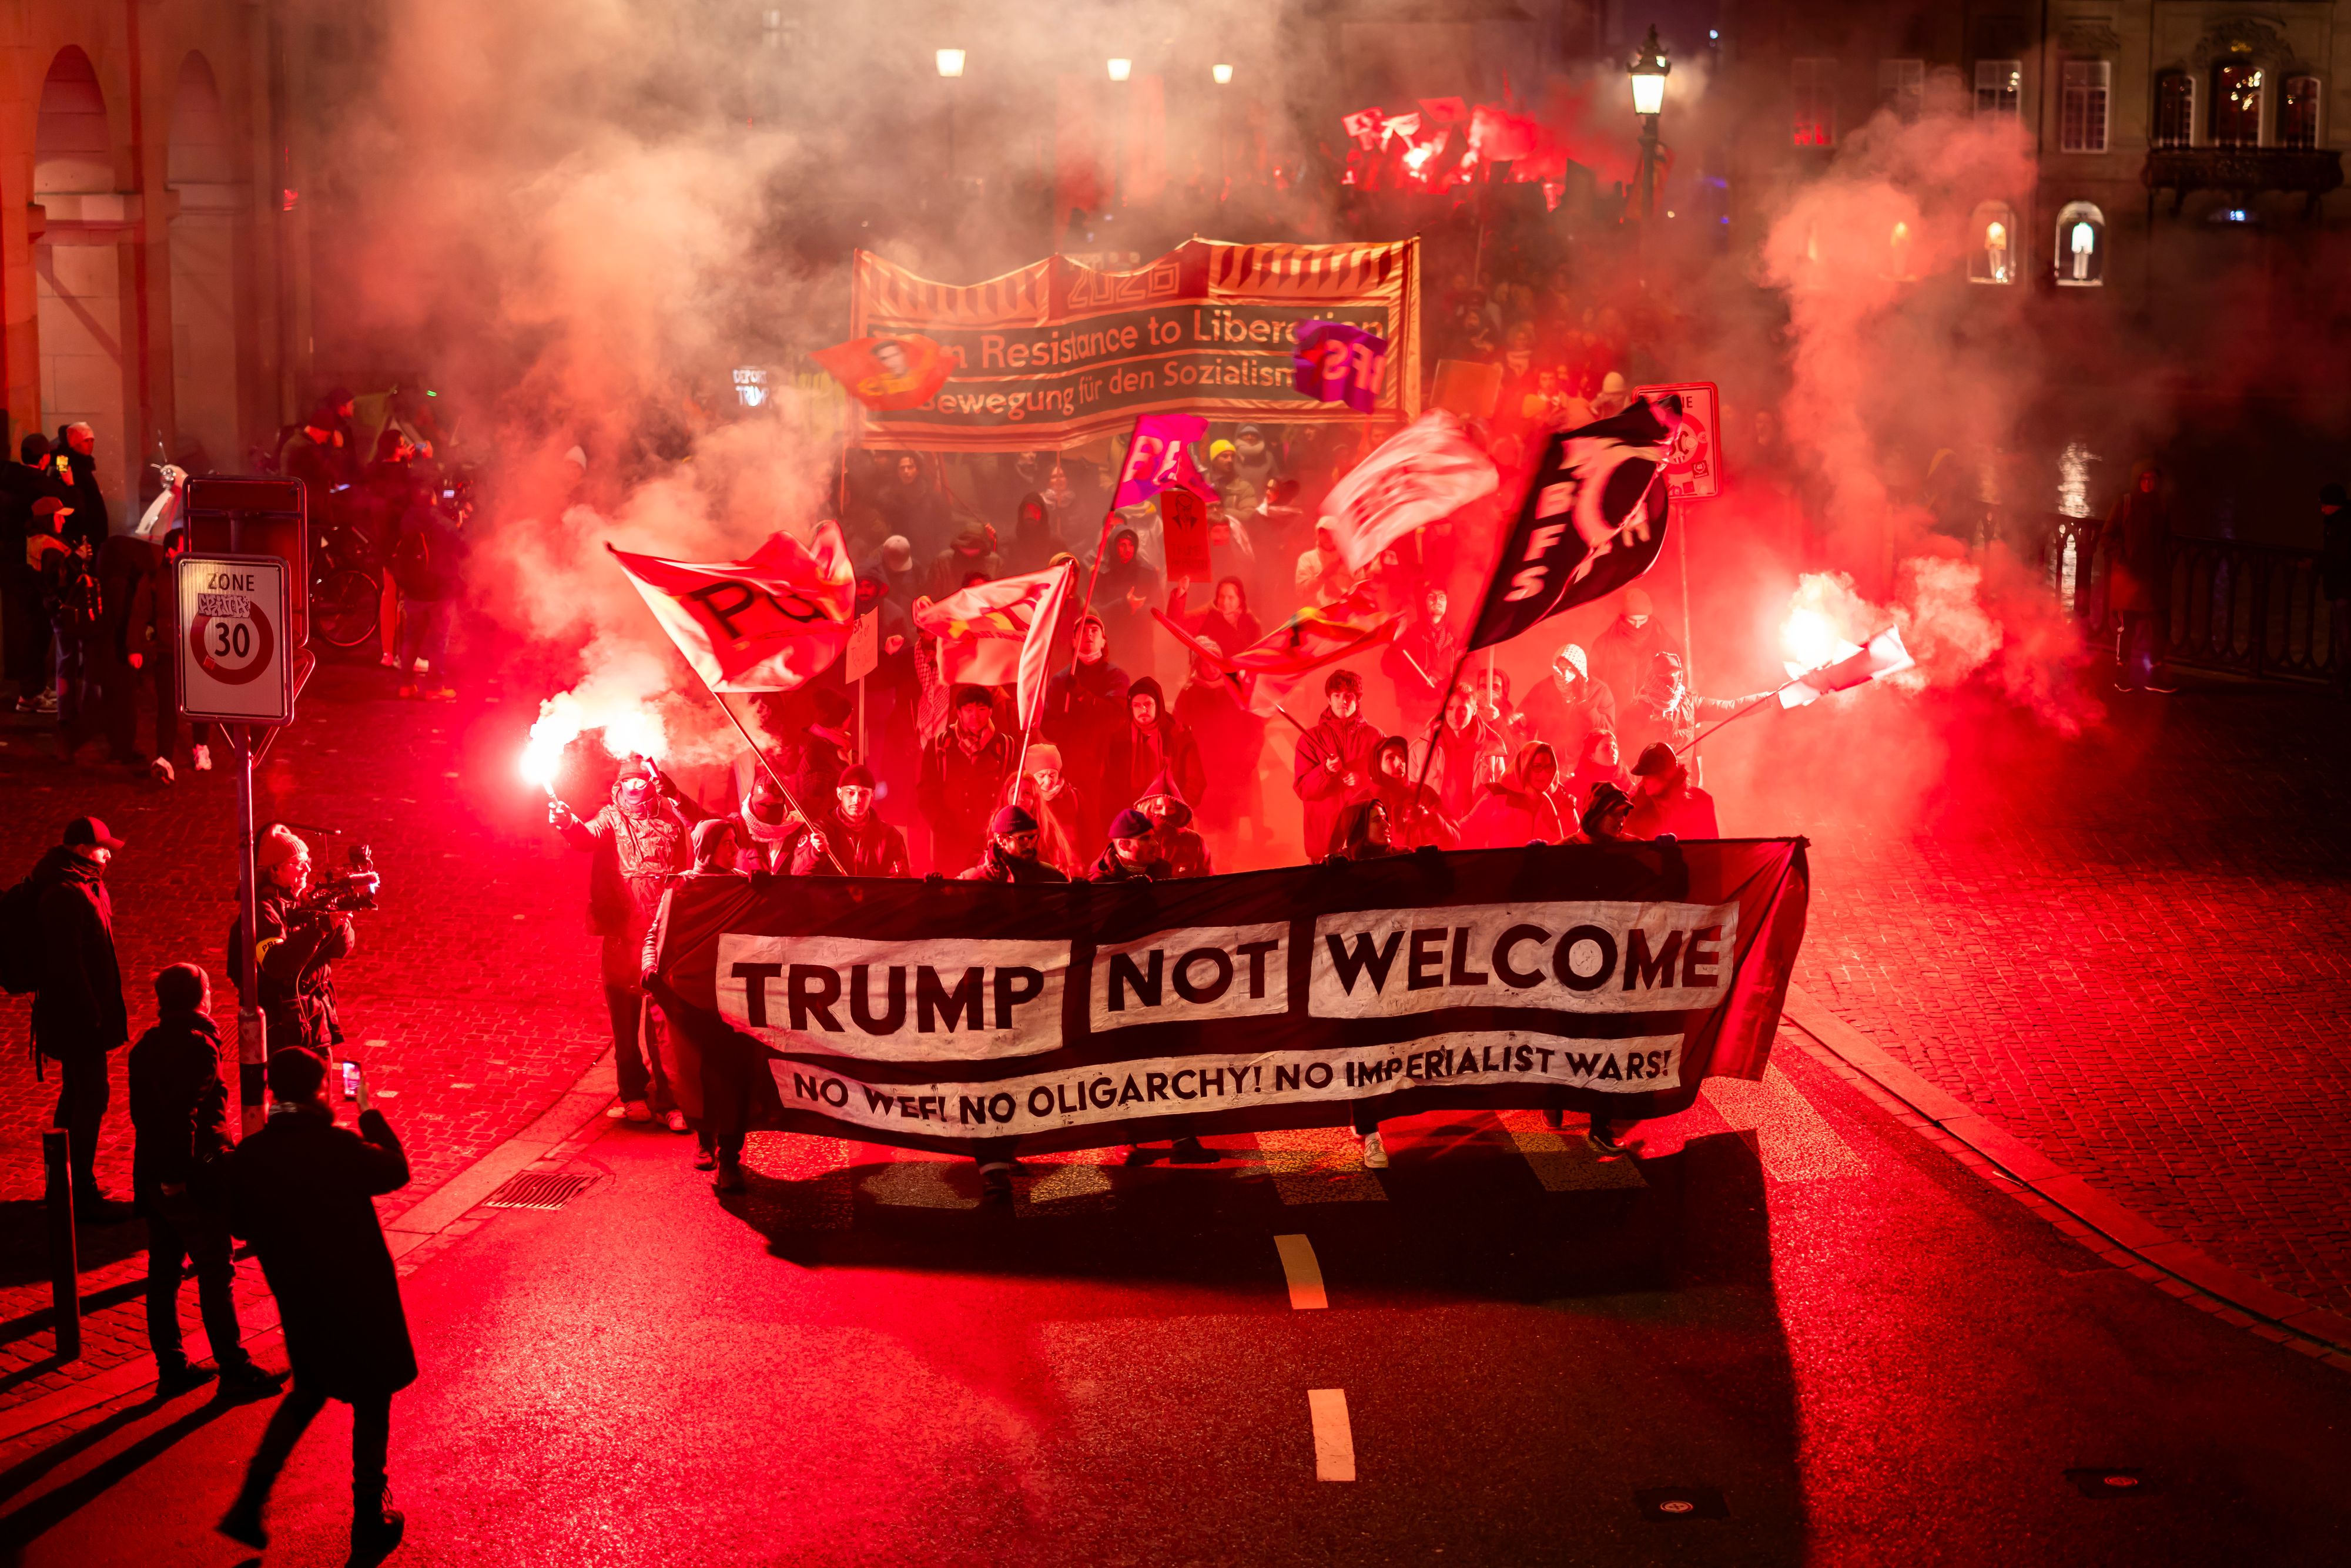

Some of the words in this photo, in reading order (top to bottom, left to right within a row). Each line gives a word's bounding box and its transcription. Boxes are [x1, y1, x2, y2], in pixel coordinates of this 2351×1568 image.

[981, 325, 1138, 368] Resistance
[1147, 316, 1181, 346] to
[1079, 376, 1103, 404] für
[1109, 368, 1154, 394] den
[208, 572, 254, 591] ZONE
[215, 622, 250, 658] 30
[731, 961, 1044, 1036] TRUMP
[1107, 940, 1278, 1011] NOT
[1325, 923, 1723, 997] WELCOME
[793, 1072, 849, 1107] NO
[861, 1084, 947, 1122] WEF!
[959, 1091, 1017, 1124] NO
[1027, 1064, 1261, 1117] OLIGARCHY!
[1275, 1062, 1334, 1091] NO
[1346, 1044, 1555, 1087] IMPERIALIST
[1565, 1049, 1672, 1082] WARS!
